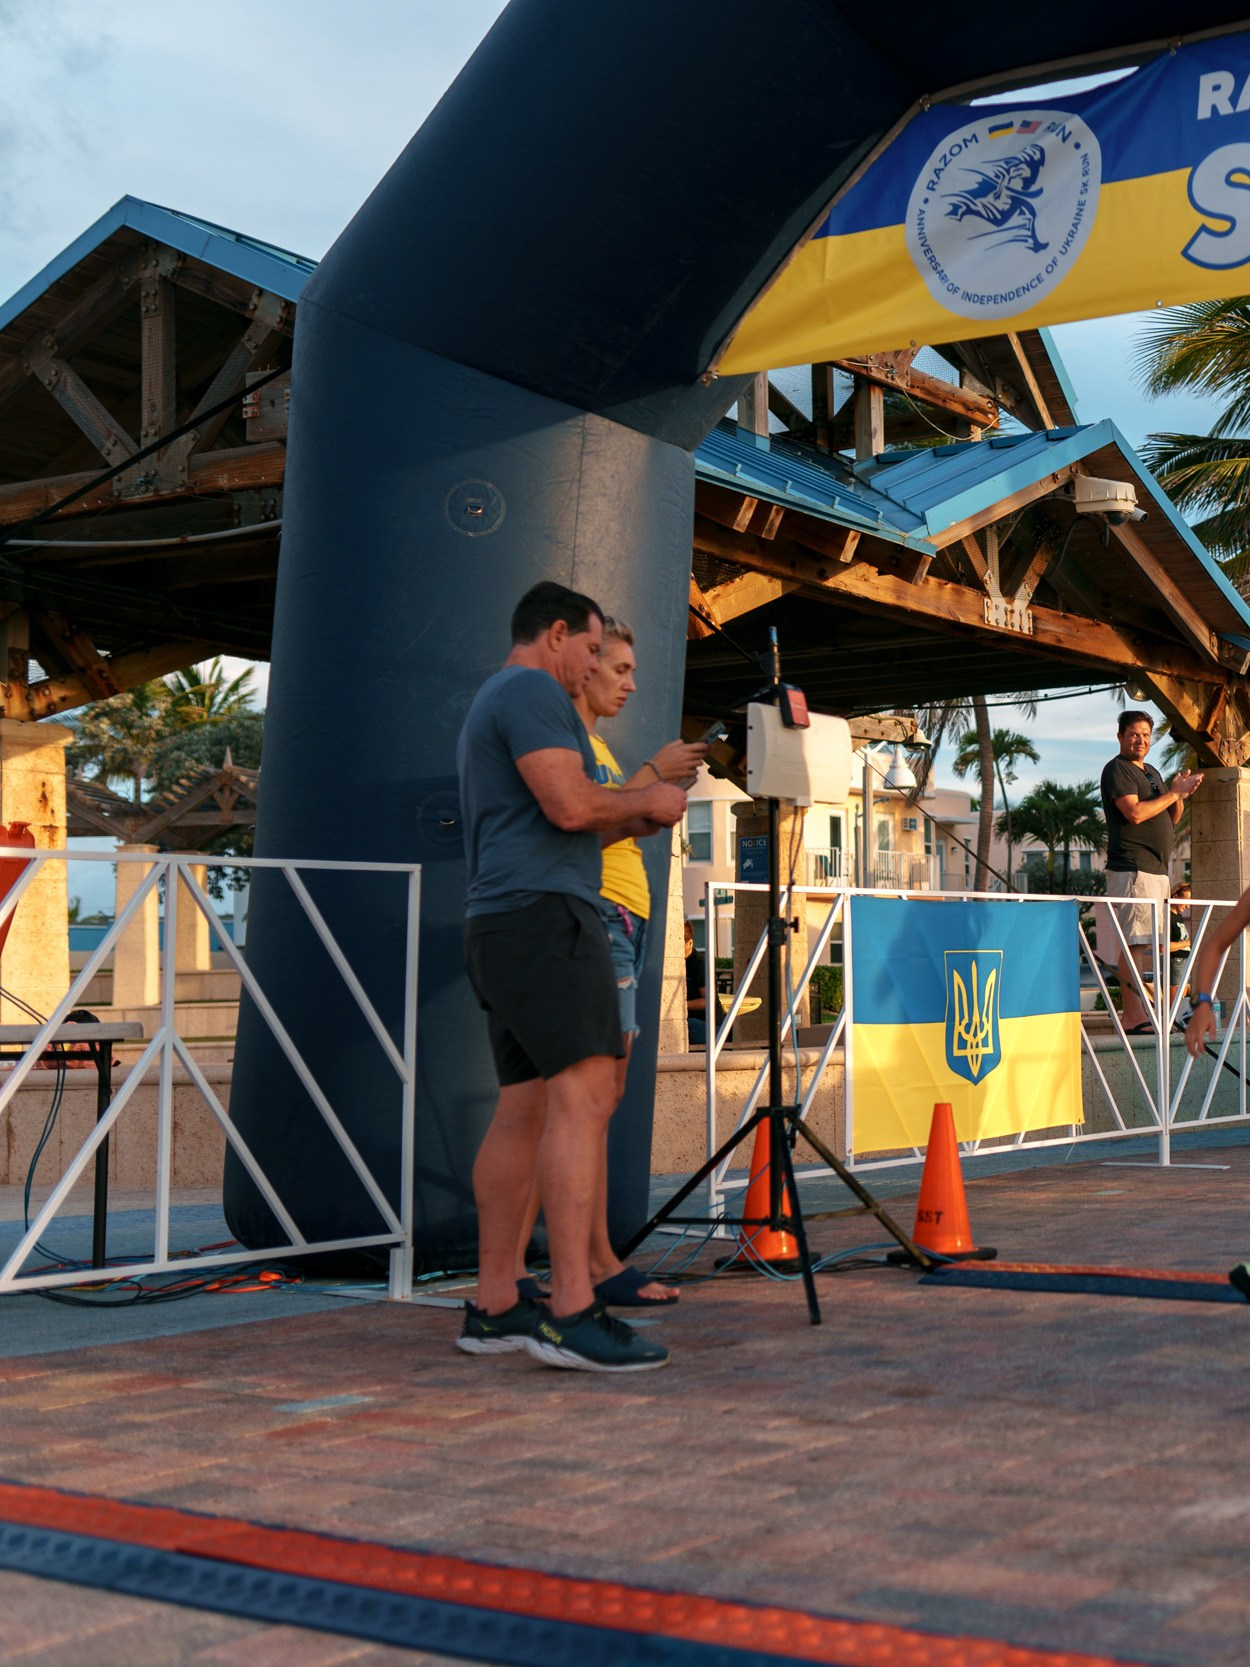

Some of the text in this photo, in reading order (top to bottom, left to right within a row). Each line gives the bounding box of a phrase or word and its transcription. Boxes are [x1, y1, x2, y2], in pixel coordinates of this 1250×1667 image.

[926, 121, 1073, 192] RAZOM RUN
[917, 152, 1090, 305] ANNIVERSARY OF INDEPENDENCE OF UKRAINE 5K RUN
[742, 839, 767, 848] NOTICE
